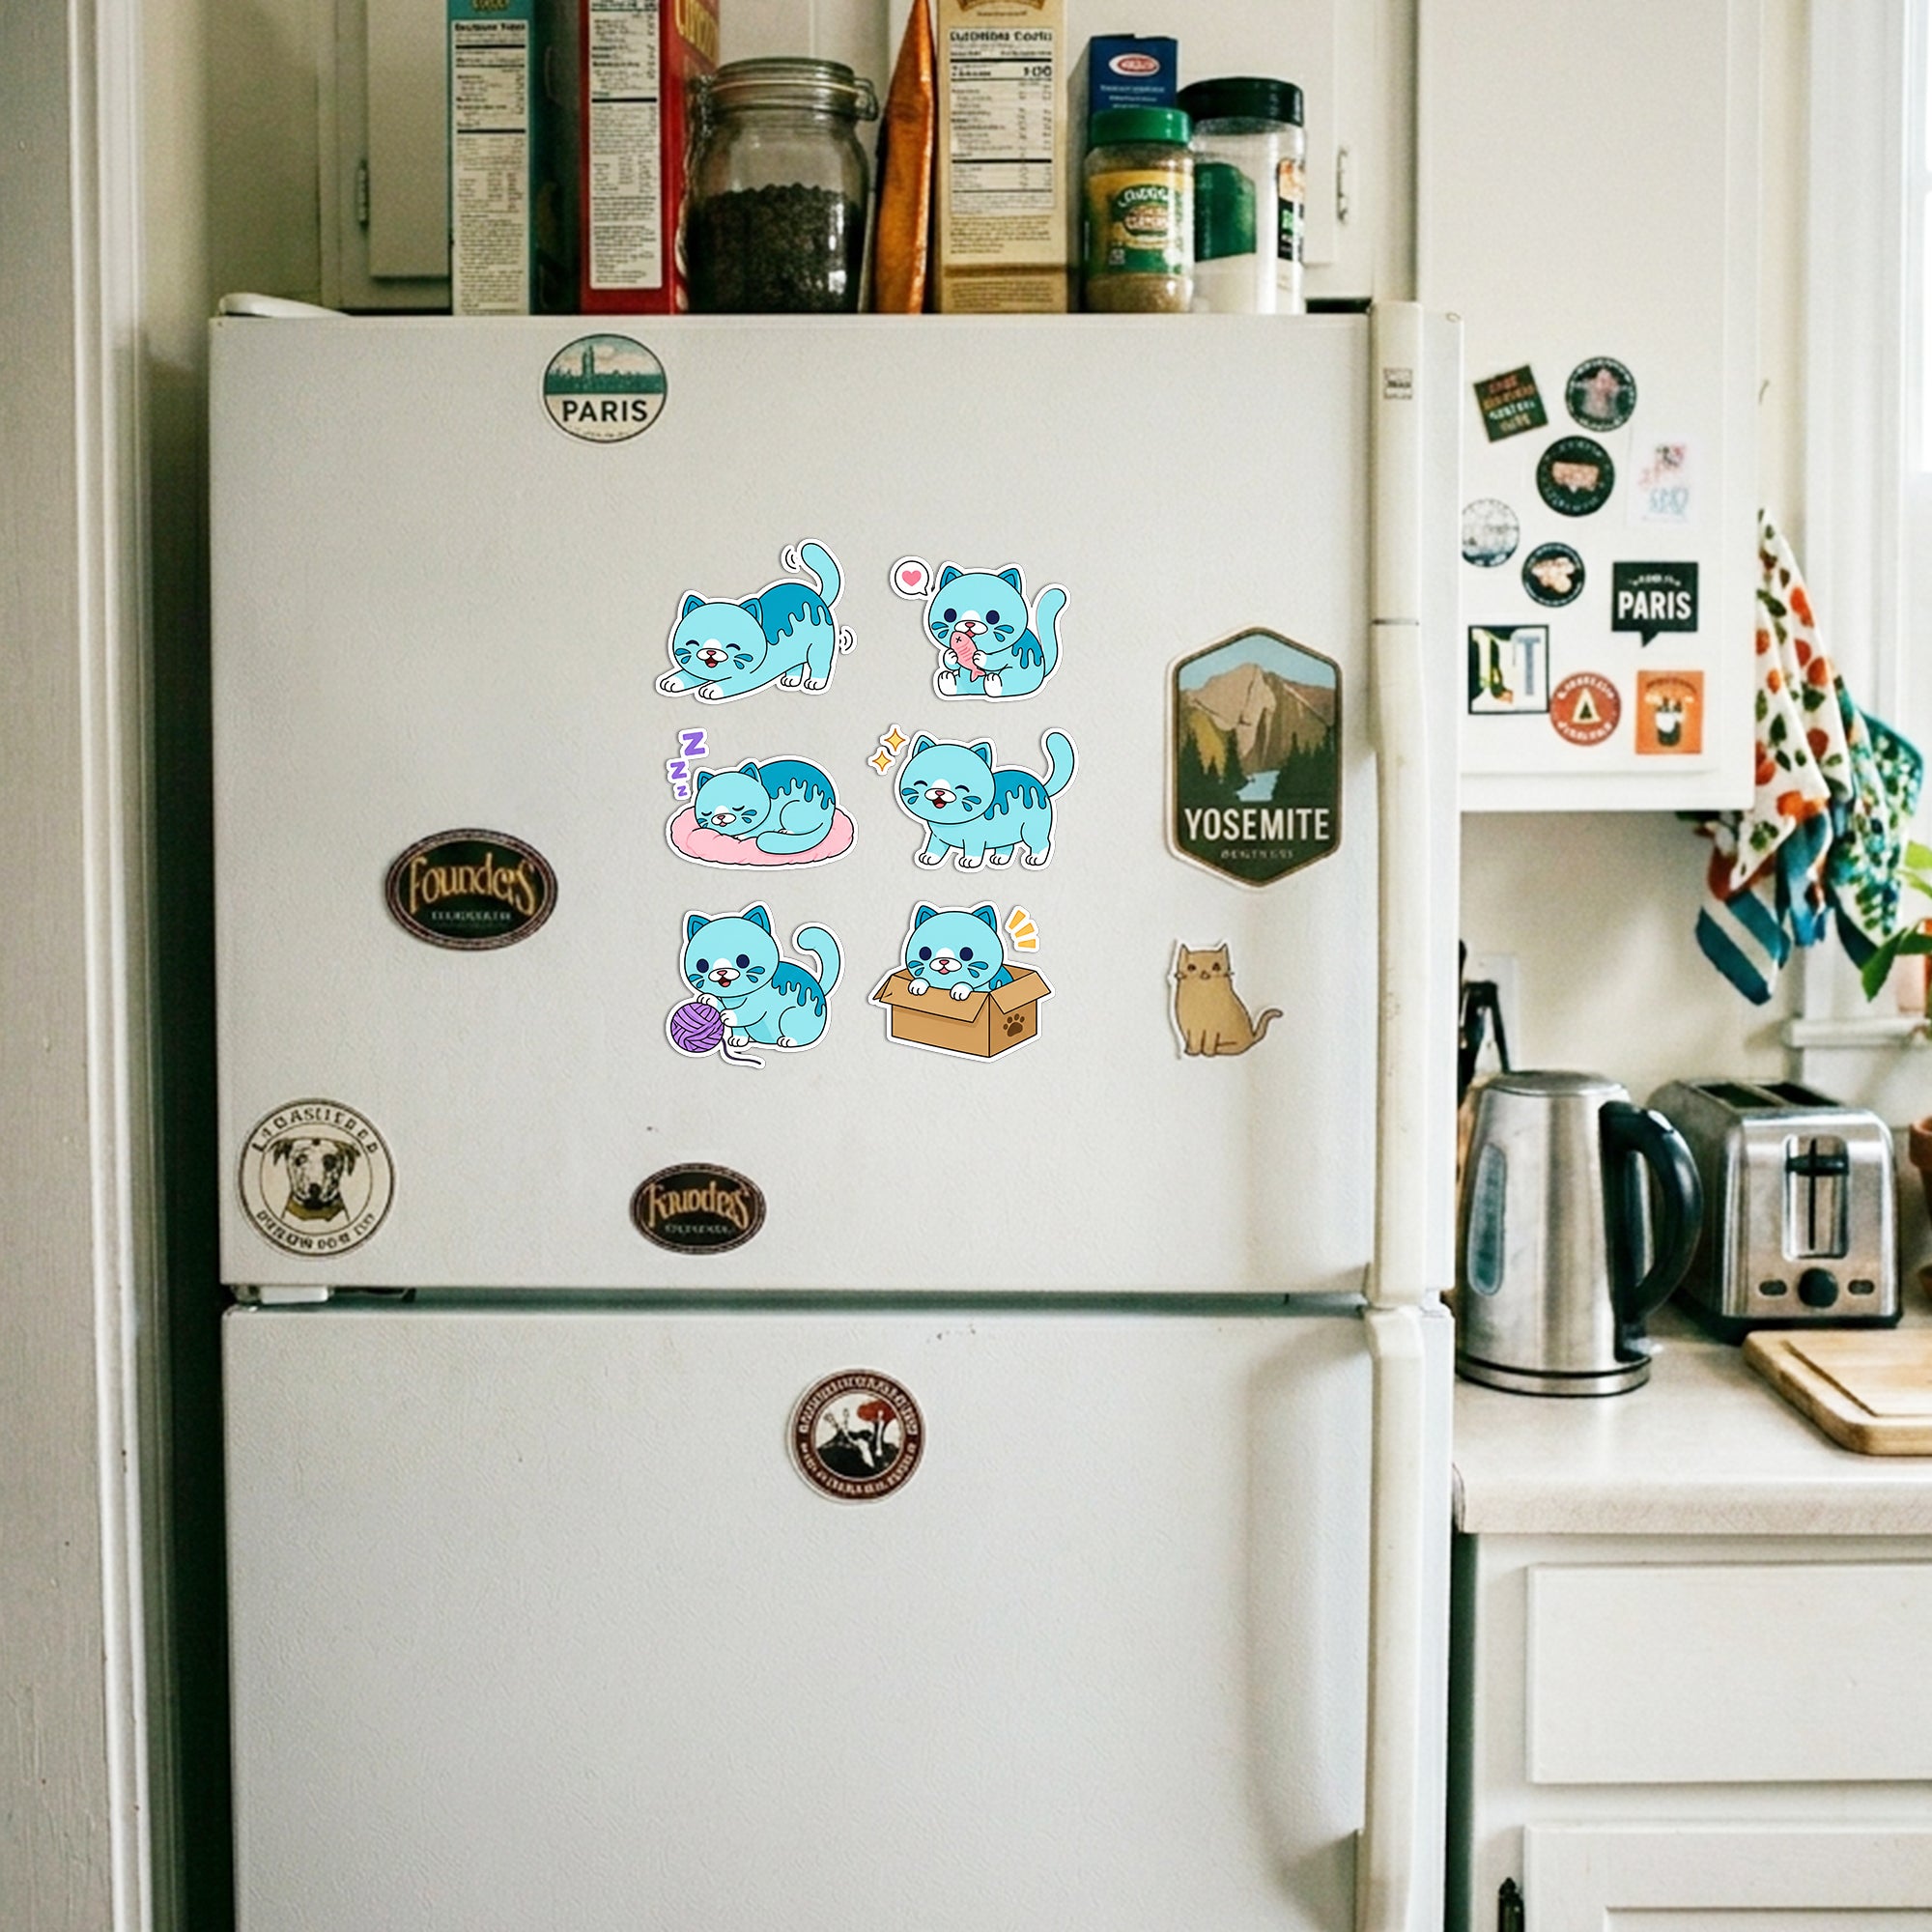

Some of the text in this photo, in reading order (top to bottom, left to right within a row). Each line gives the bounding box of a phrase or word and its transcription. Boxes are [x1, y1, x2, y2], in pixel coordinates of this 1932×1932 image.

[562, 400, 648, 422] PARIS
[1618, 590, 1692, 619] PARIS
[1184, 808, 1329, 840] YOSEMITE
